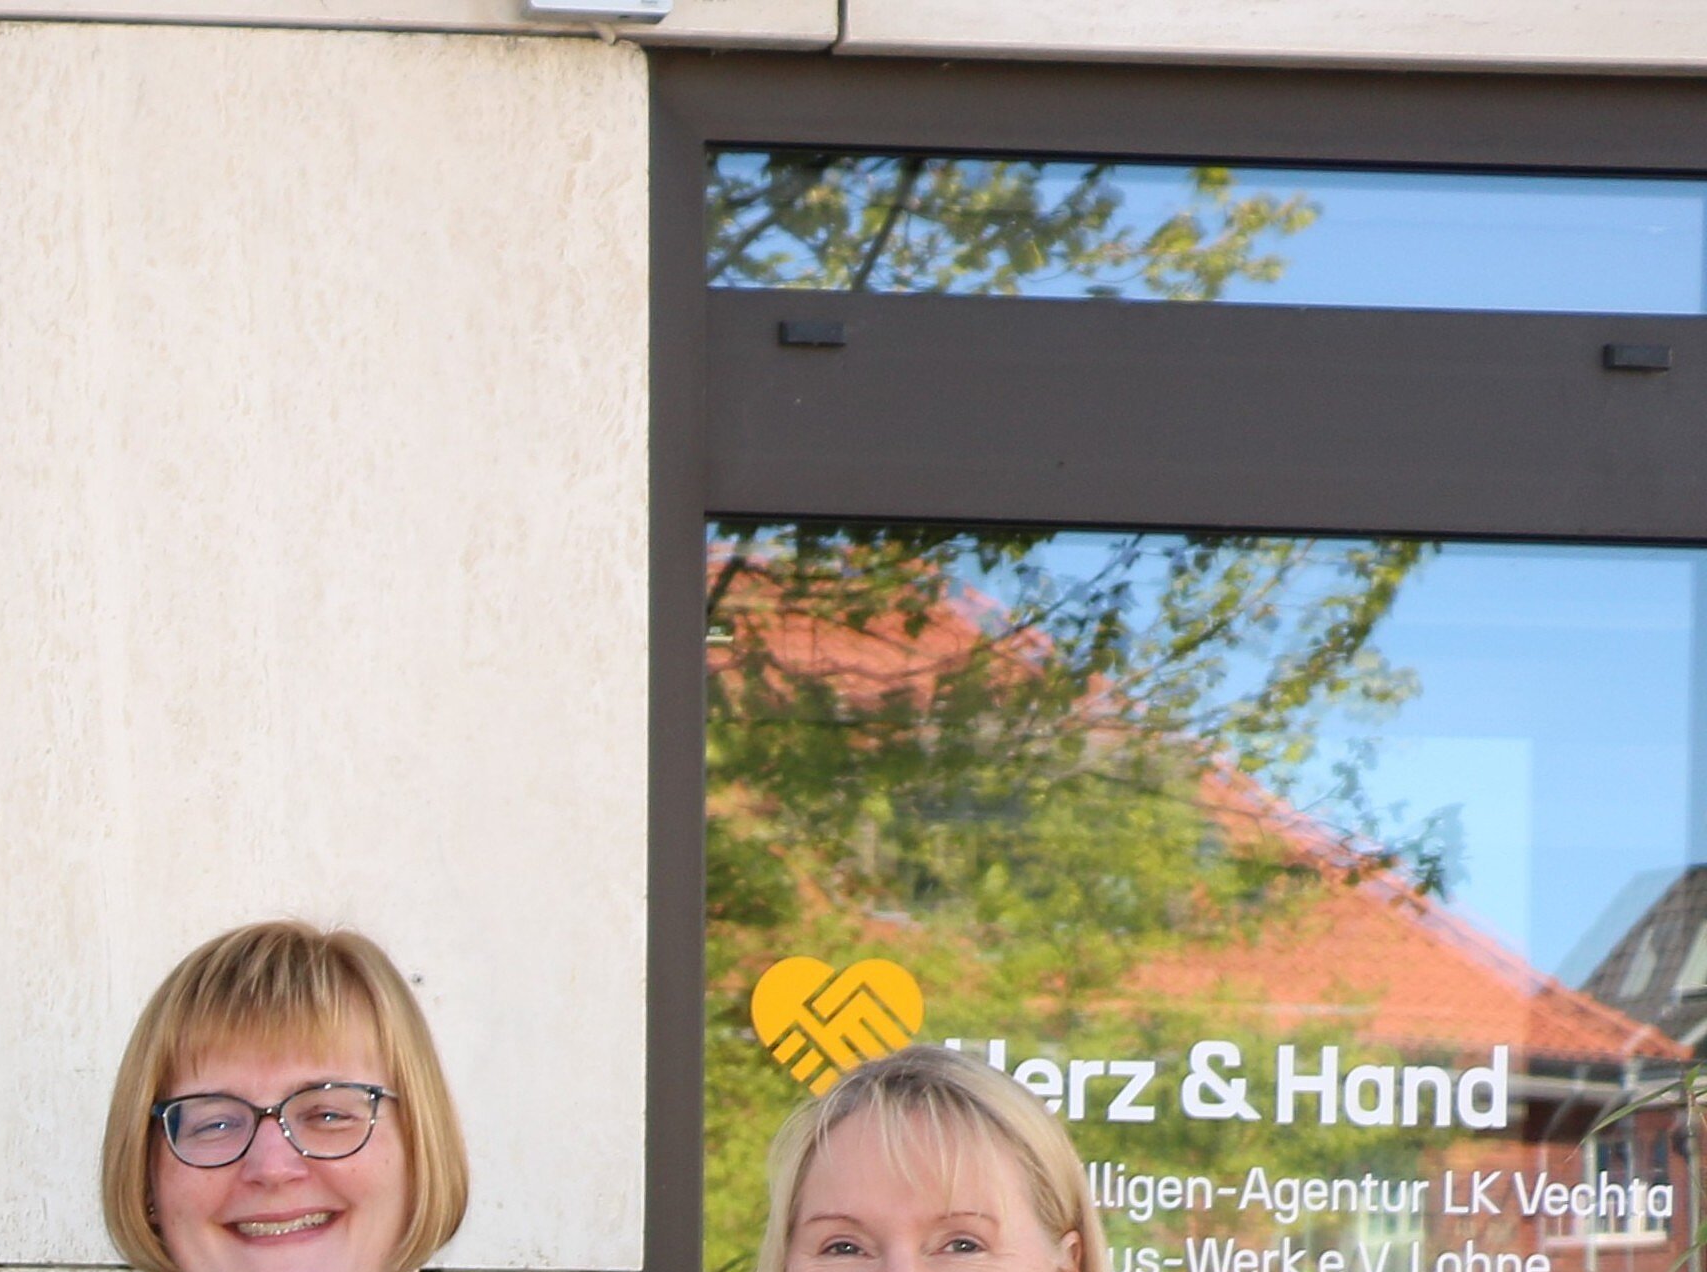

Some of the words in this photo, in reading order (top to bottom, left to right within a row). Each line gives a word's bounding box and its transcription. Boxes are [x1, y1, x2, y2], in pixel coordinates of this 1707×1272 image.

[1181, 1040, 1262, 1121] &
[1276, 1044, 1509, 1129] Hand
[1089, 1161, 1430, 1225] lligen-Agentur
[1444, 1170, 1501, 1215] LK
[1513, 1171, 1674, 1218] Vechta
